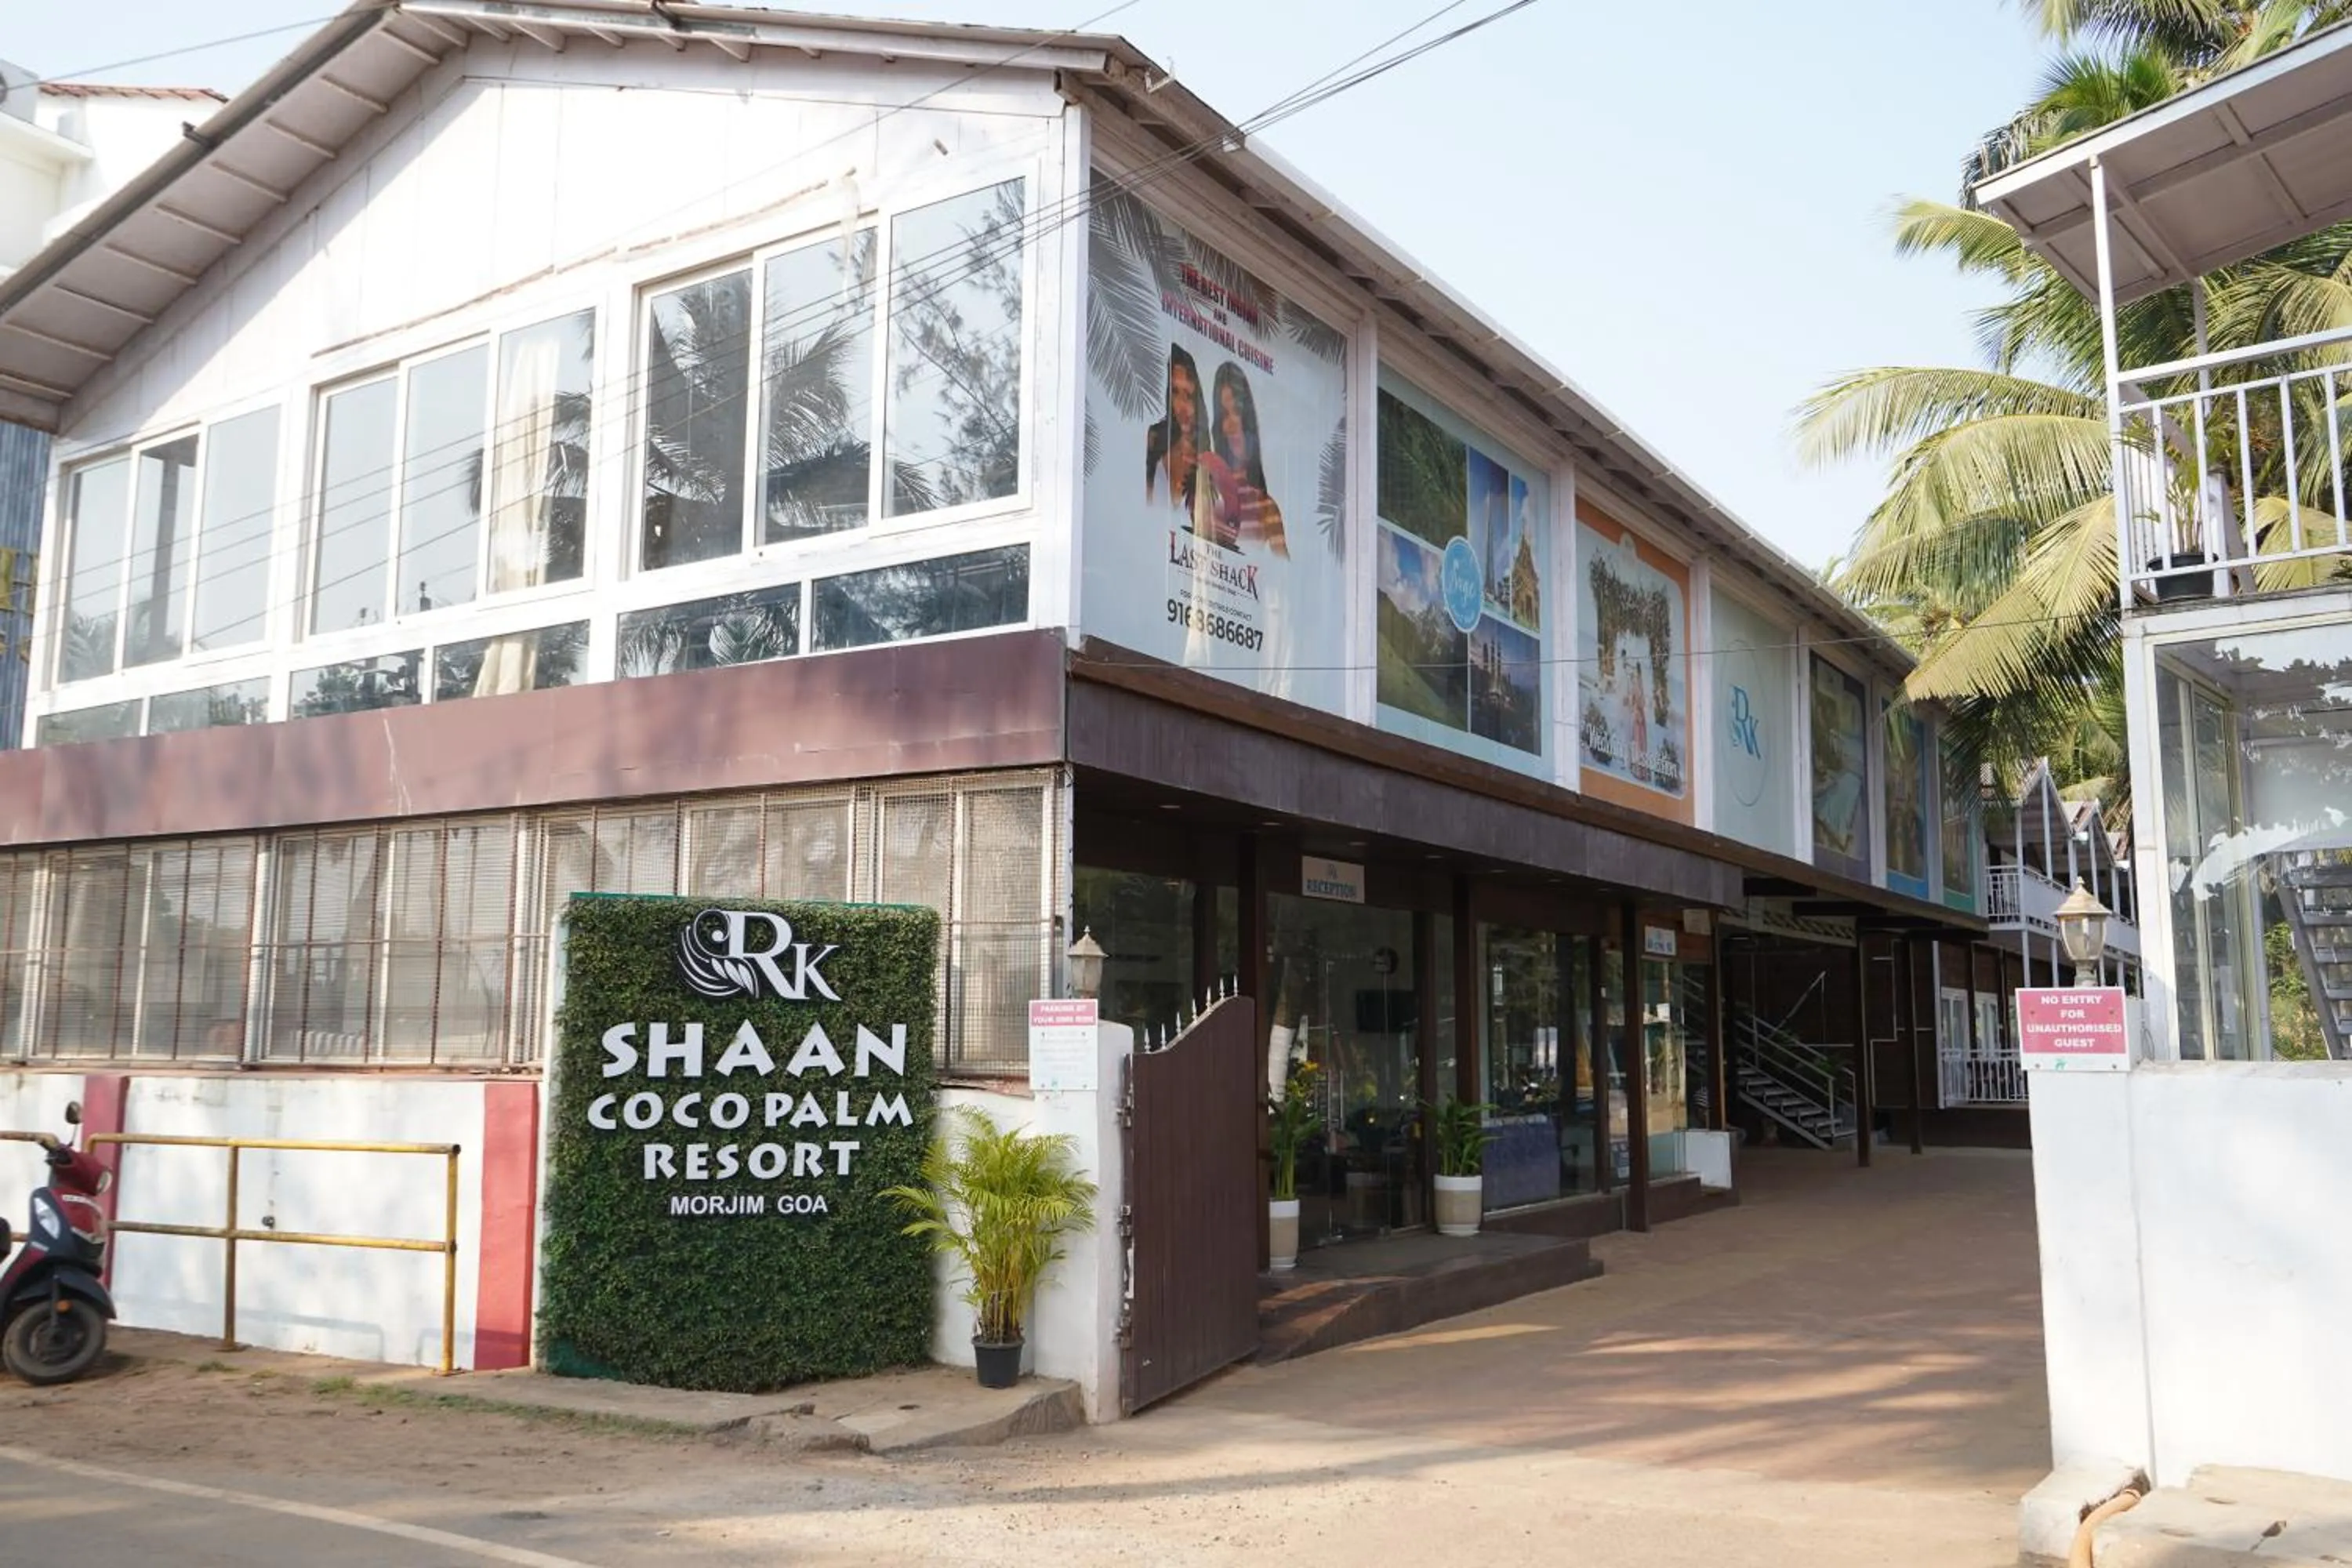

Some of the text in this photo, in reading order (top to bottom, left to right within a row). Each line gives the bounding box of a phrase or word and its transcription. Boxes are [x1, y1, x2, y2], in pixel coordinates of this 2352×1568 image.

[1200, 274, 1225, 306] BEST
[1161, 288, 1274, 376] INTERNATIONAL CUISINE
[1210, 561, 1259, 604] SHACK
[1307, 880, 1356, 898] RECEPTION
[2041, 995, 2103, 1004] NO ENTRY
[2060, 1009, 2085, 1018] FOR
[2026, 1023, 2123, 1033] UNAUTHORISED
[601, 1018, 908, 1079] SHAAN
[2054, 1038, 2096, 1047] GUEST
[644, 1141, 860, 1181] RESORT
[670, 1194, 829, 1215] MORJIM GOA
